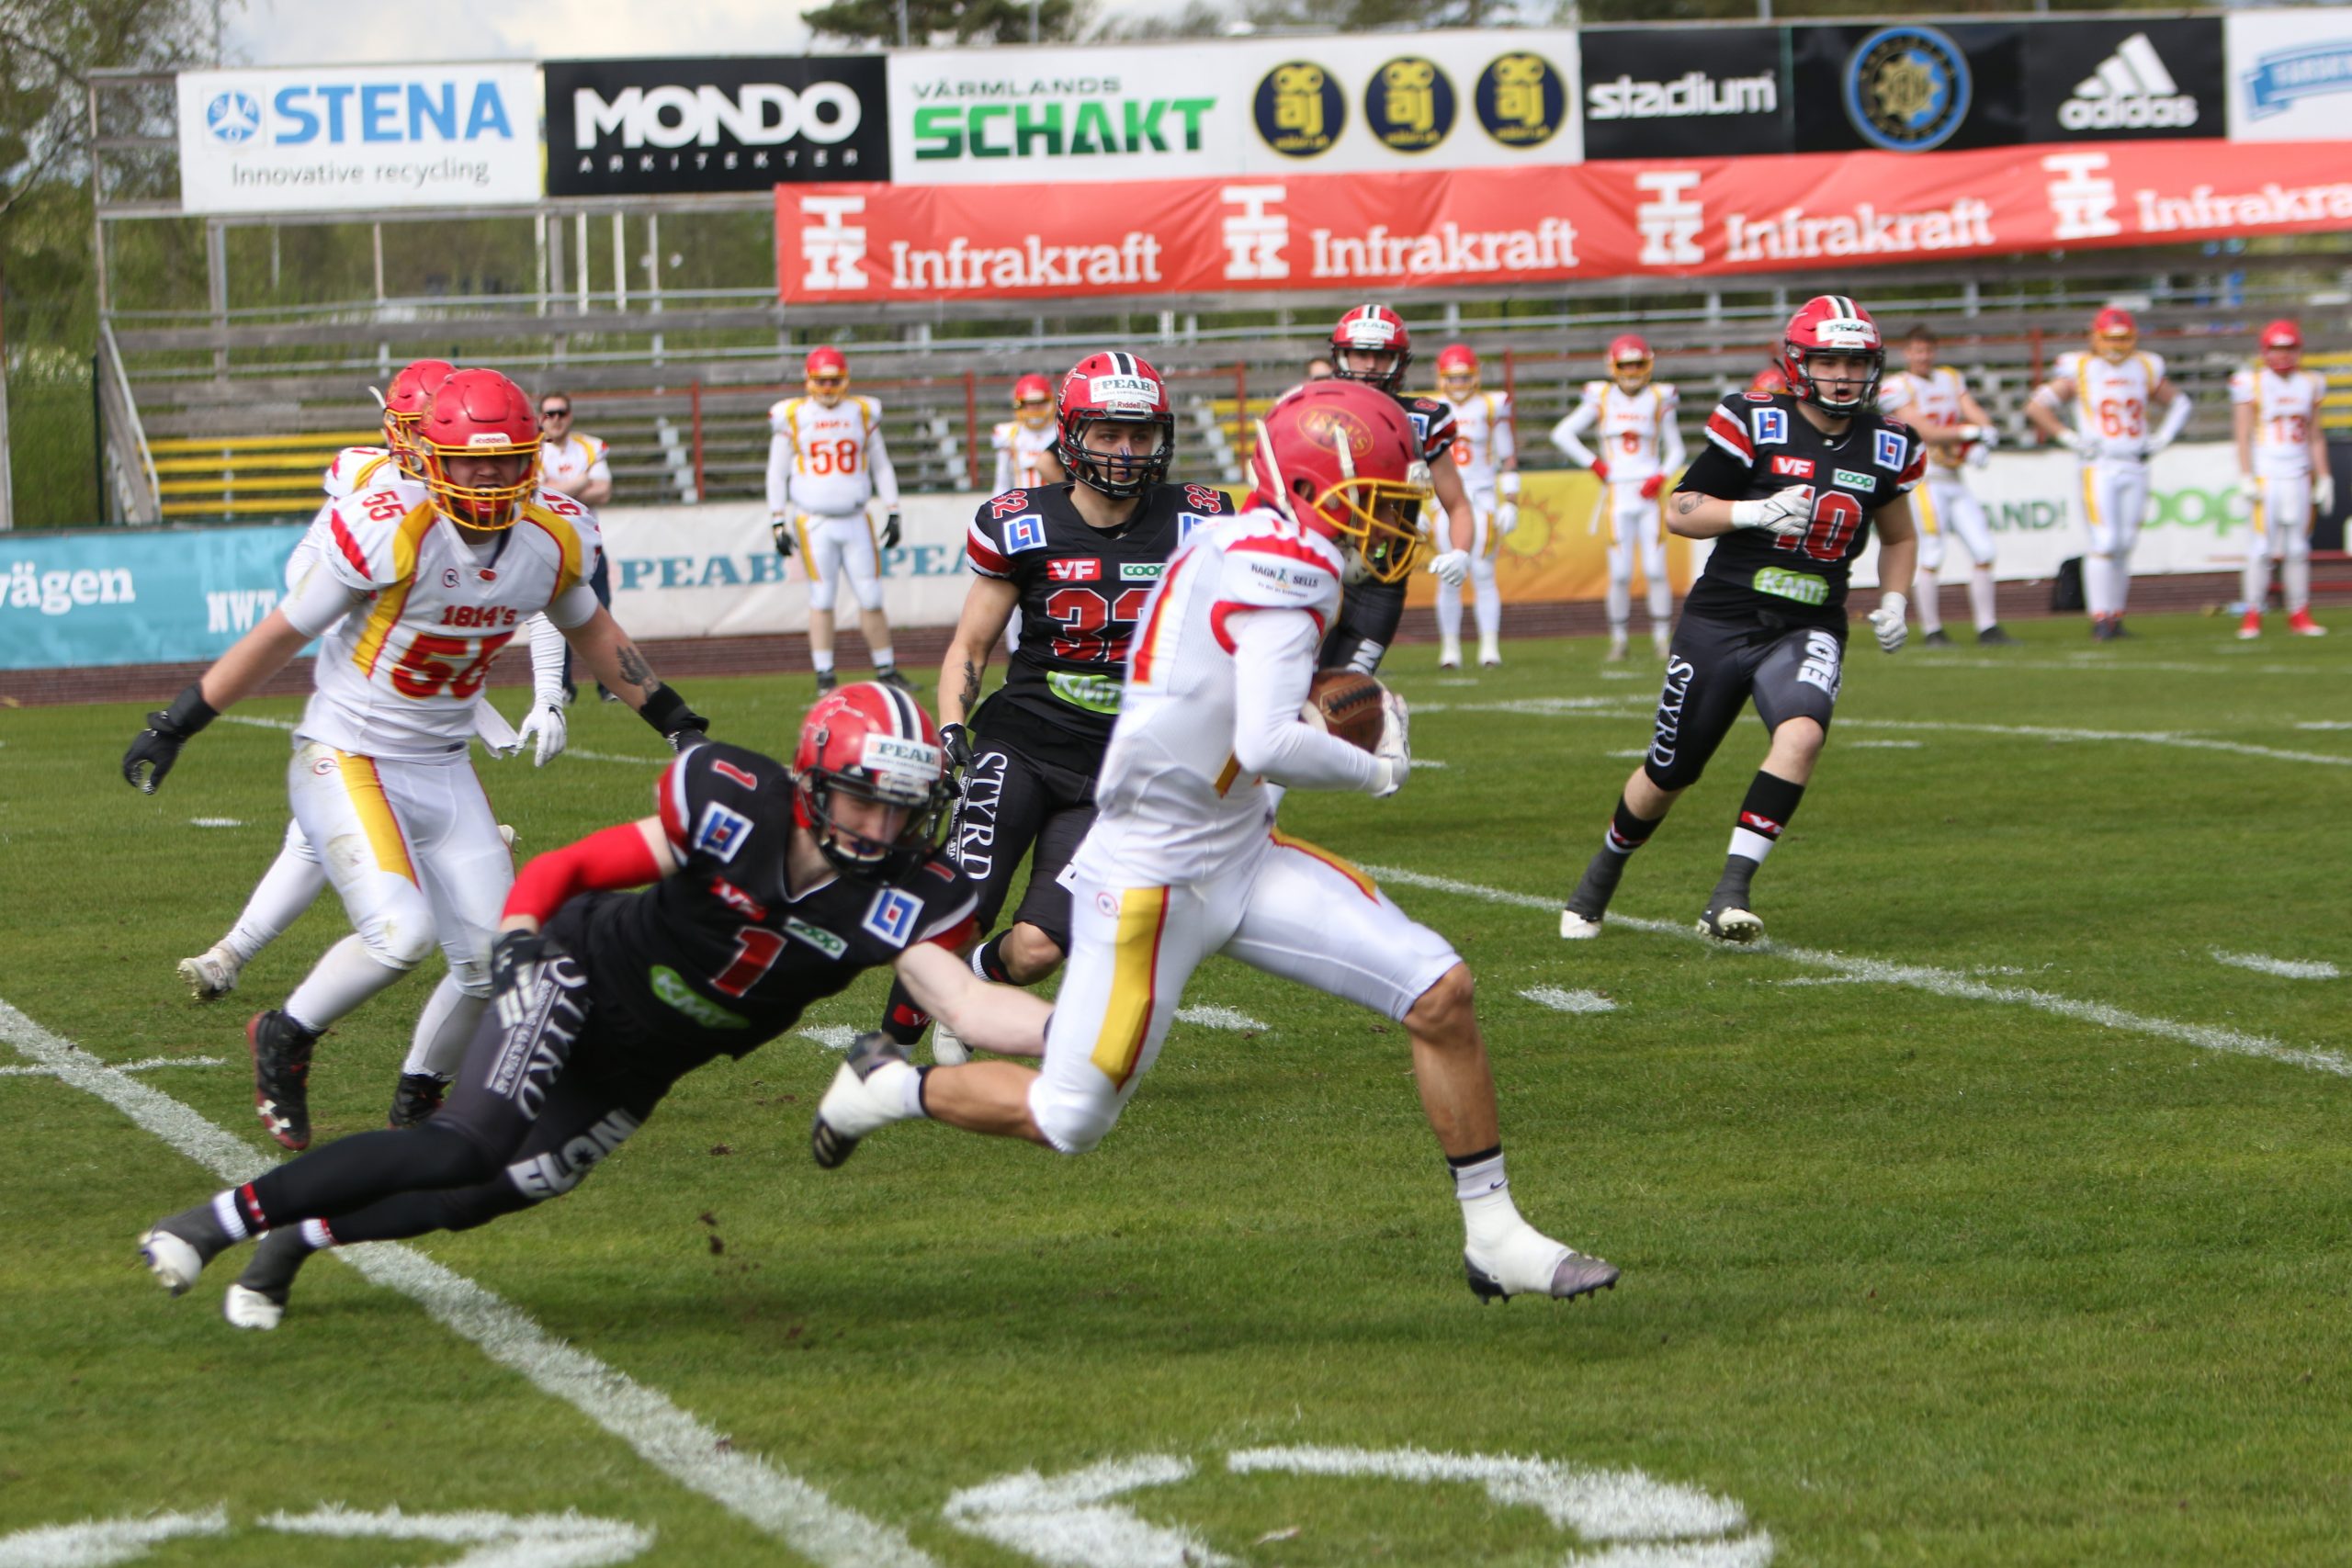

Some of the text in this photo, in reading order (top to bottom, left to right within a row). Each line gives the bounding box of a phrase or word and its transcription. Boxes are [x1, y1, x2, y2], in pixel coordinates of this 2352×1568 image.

[913, 77, 1122, 98] VÄRMLANDS
[1588, 73, 1777, 119] stadium
[275, 80, 514, 144] STENA
[573, 81, 862, 150] MONDO
[913, 96, 1218, 160] SCHAKT
[2059, 95, 2199, 130] adidas
[232, 156, 491, 187] Innovative recycling
[578, 149, 858, 173] ARKITEKTER
[1311, 218, 1579, 277] Infrakraft
[1725, 197, 1996, 263] Infrakraft
[890, 233, 1162, 289] Infrakraft
[1102, 378, 1151, 392] PEAB
[1117, 401, 1141, 410] Riddell
[2100, 399, 2143, 438] 63
[810, 438, 858, 475] 58
[1776, 457, 1812, 477] VF
[1838, 470, 1874, 488] coop
[362, 490, 407, 522] 55
[992, 490, 1028, 519] 32
[1184, 484, 1222, 514] 32
[617, 553, 786, 591] PEAB
[1052, 559, 1095, 581] VF
[206, 589, 277, 634] NWT
[441, 605, 517, 627] 1814's
[712, 760, 758, 792] 1
[960, 750, 1008, 880] STYRD
[709, 926, 787, 998] 1
